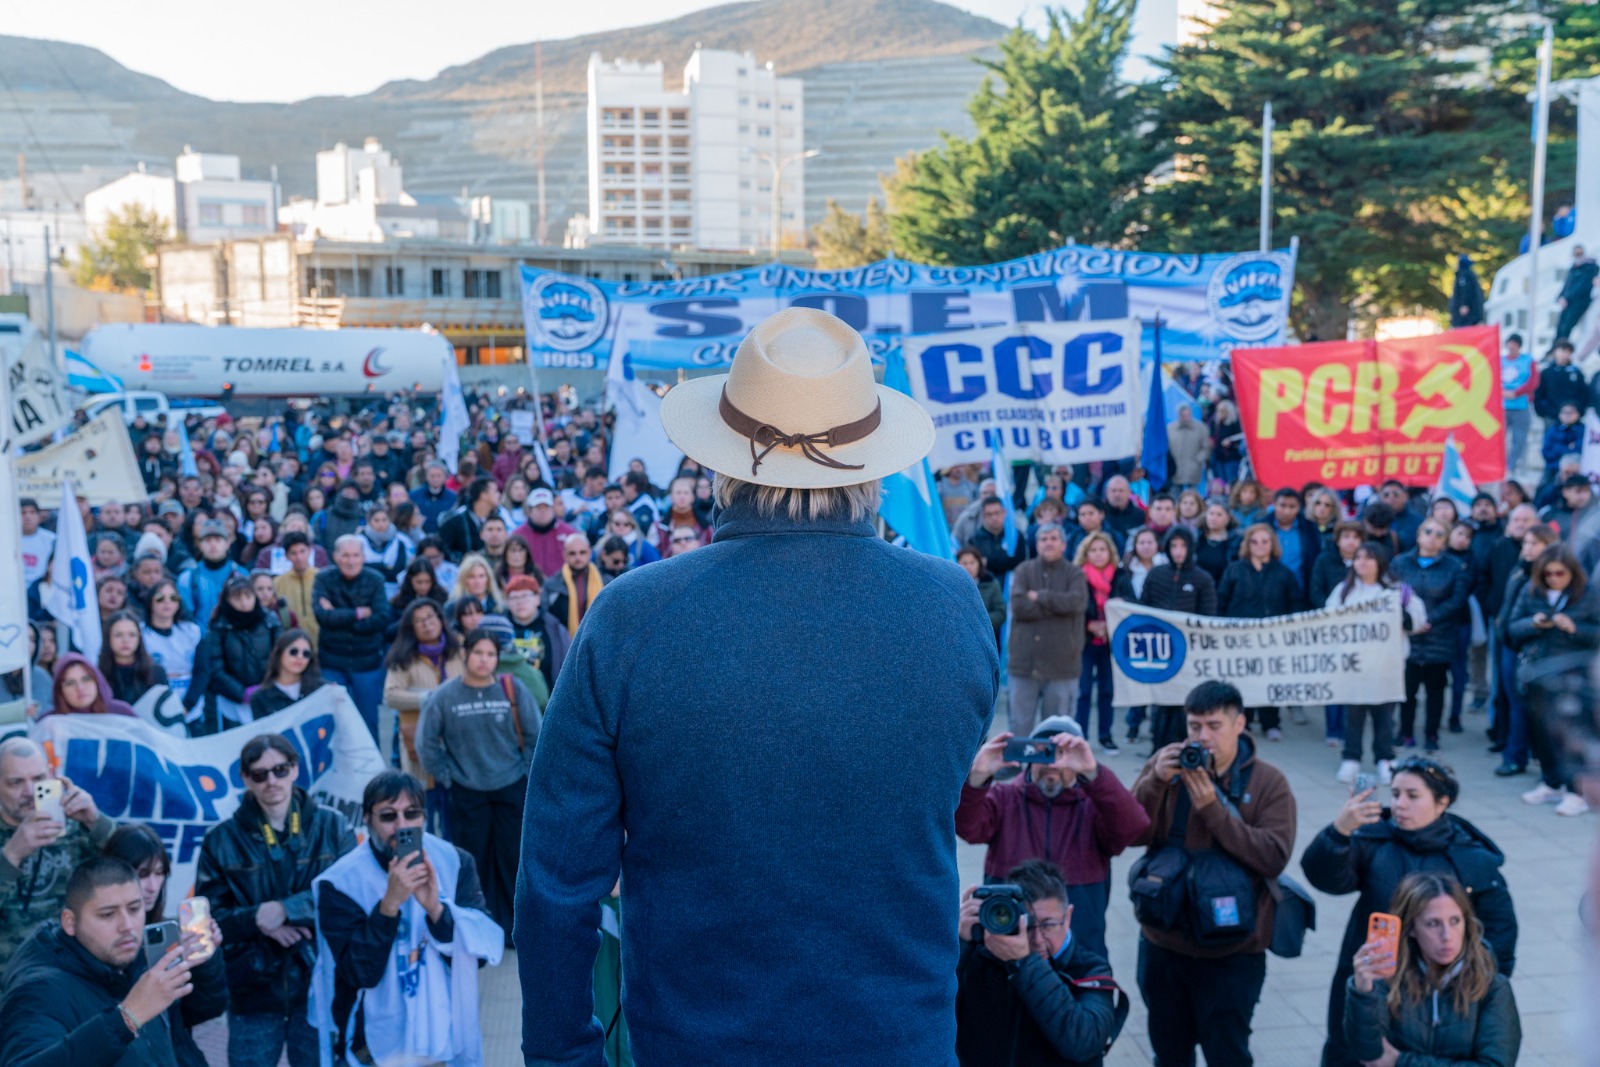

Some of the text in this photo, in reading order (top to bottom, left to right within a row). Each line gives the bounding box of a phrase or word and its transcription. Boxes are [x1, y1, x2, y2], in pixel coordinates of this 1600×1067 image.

[925, 250, 1200, 285] CONDUCCION
[222, 356, 316, 374] TOMREL
[920, 332, 1124, 404] CCC
[1050, 408, 1056, 423] Y
[1061, 401, 1127, 421] COMBATIVA
[1256, 360, 1399, 439] PCR
[954, 425, 1106, 451] CHUBUT
[1320, 456, 1442, 479] CHUBUT
[1127, 632, 1171, 664] ETU
[1189, 621, 1390, 650] FUE QUE LA UNIVERSIDAD
[1194, 651, 1362, 678] SE LLENO DE HIJOS DE
[1266, 681, 1334, 702] OBREROS
[65, 713, 336, 821] UNPB
